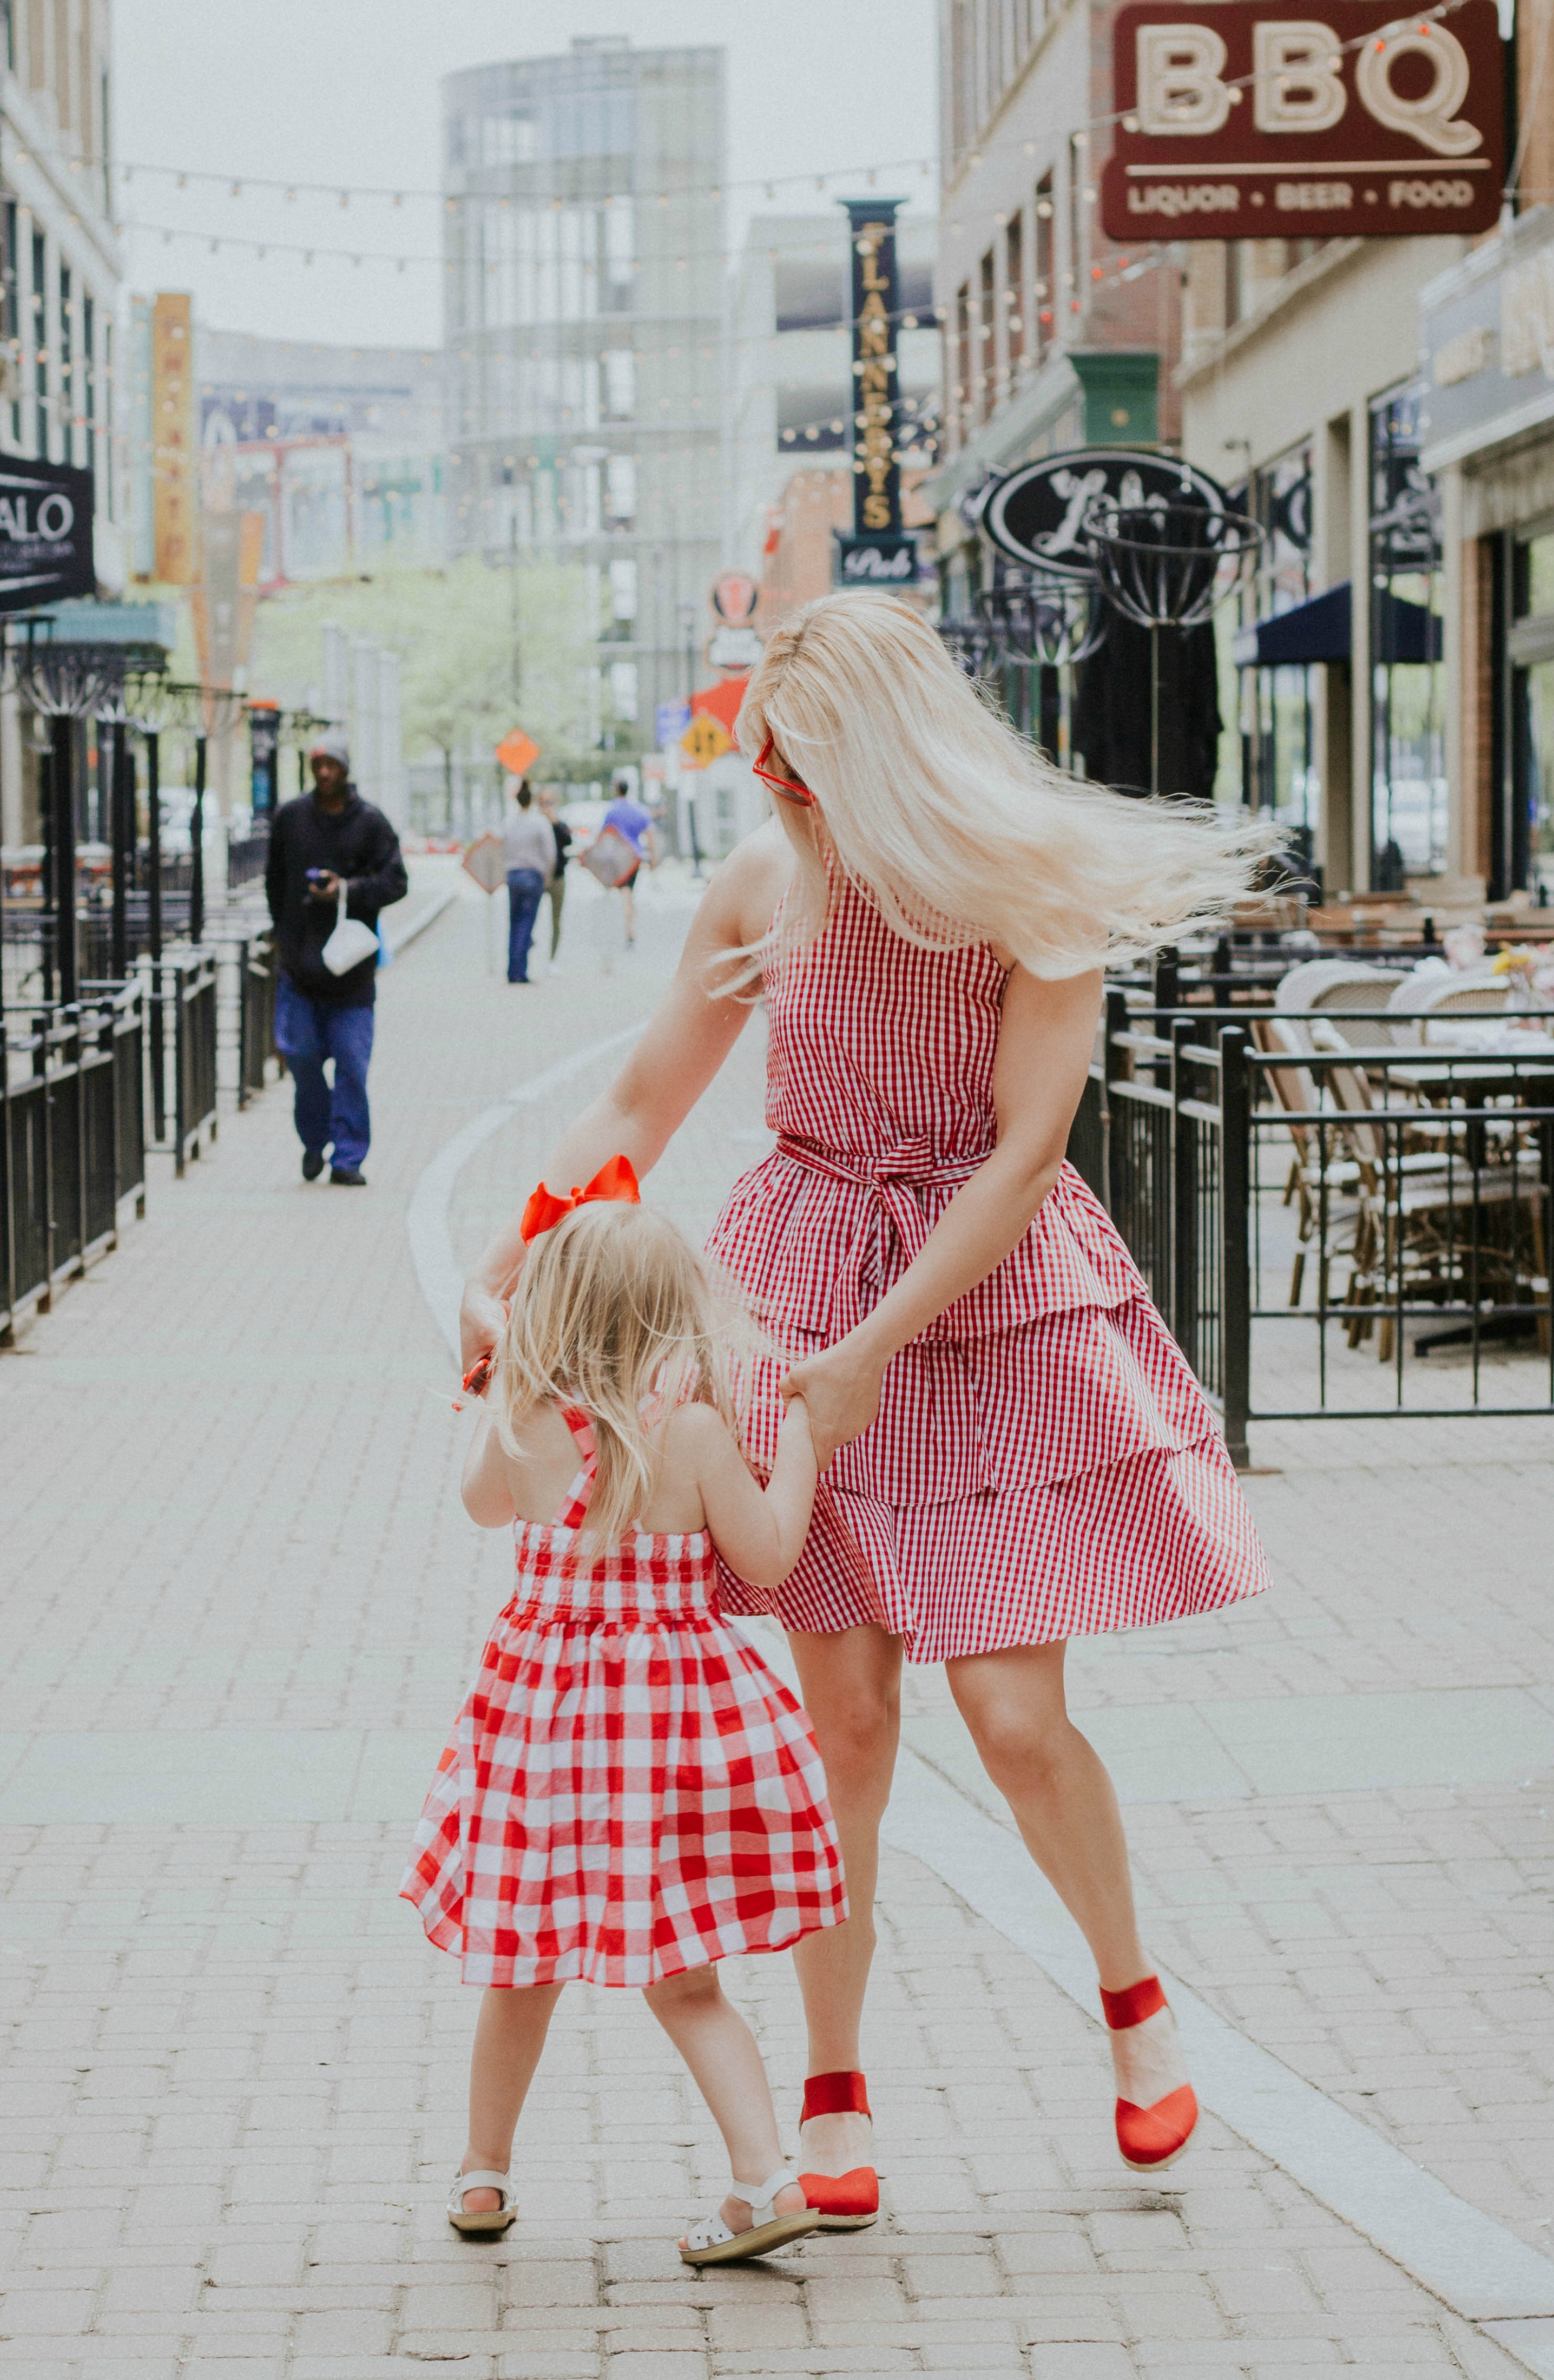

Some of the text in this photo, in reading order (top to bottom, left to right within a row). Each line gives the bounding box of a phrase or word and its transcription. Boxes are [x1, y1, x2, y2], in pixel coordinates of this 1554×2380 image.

[1136, 19, 1484, 156] BBQ
[1127, 179, 1476, 217] LIQUOR BEER FOOD
